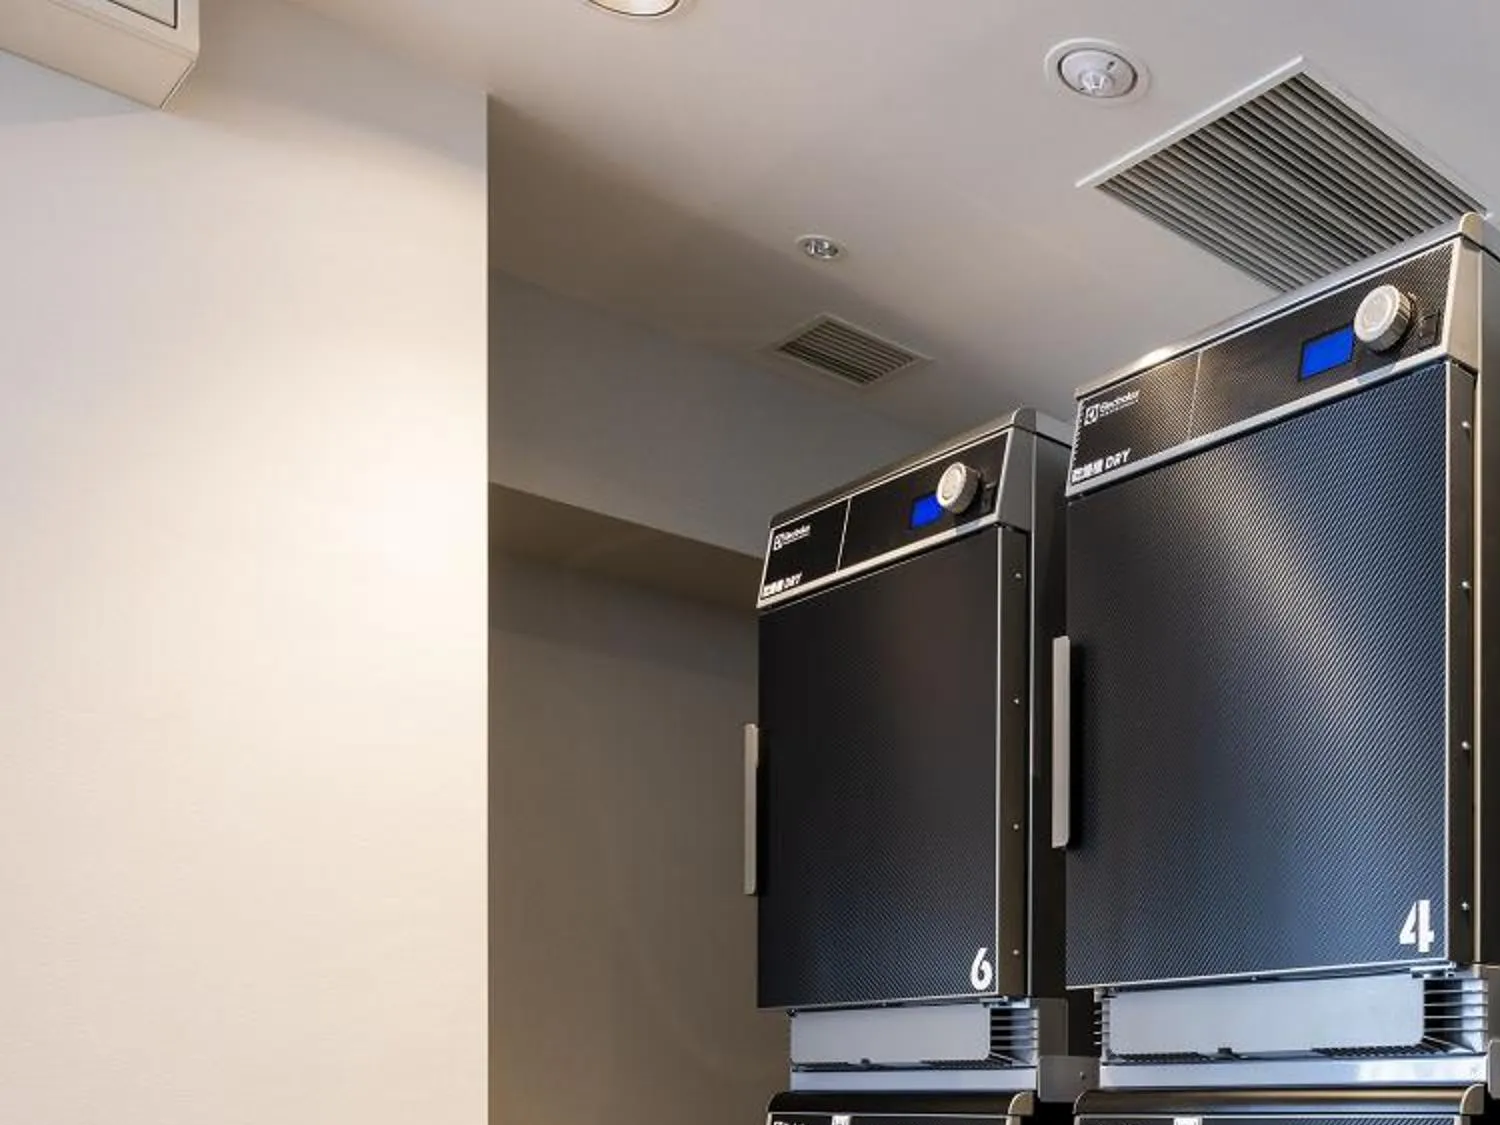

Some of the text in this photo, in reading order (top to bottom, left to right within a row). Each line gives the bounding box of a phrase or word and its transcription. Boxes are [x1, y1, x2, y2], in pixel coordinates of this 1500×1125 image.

[1105, 448, 1131, 470] DRY
[1398, 899, 1435, 953] 4
[970, 947, 993, 991] 6
